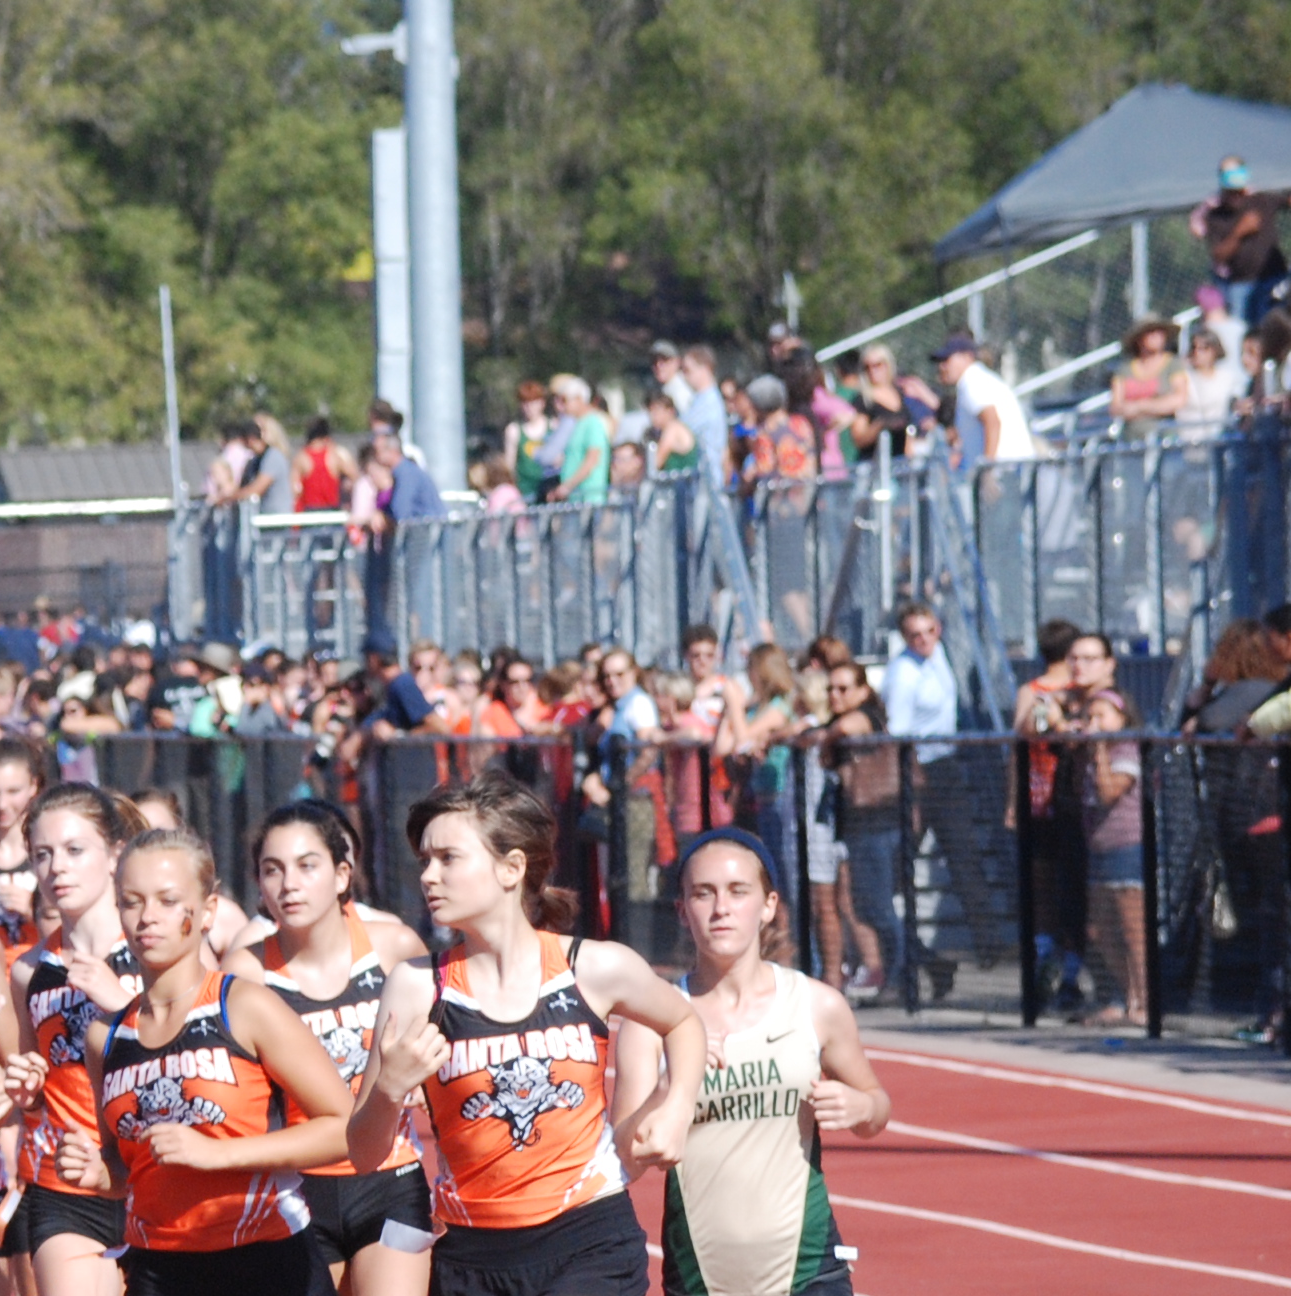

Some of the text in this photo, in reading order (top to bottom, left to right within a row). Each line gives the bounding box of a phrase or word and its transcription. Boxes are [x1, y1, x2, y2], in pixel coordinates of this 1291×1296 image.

[525, 1022, 599, 1064] ROSA
[165, 1047, 237, 1086] ROSA
[703, 1057, 783, 1096] MARIA
[692, 1088, 799, 1125] CARRILLO
